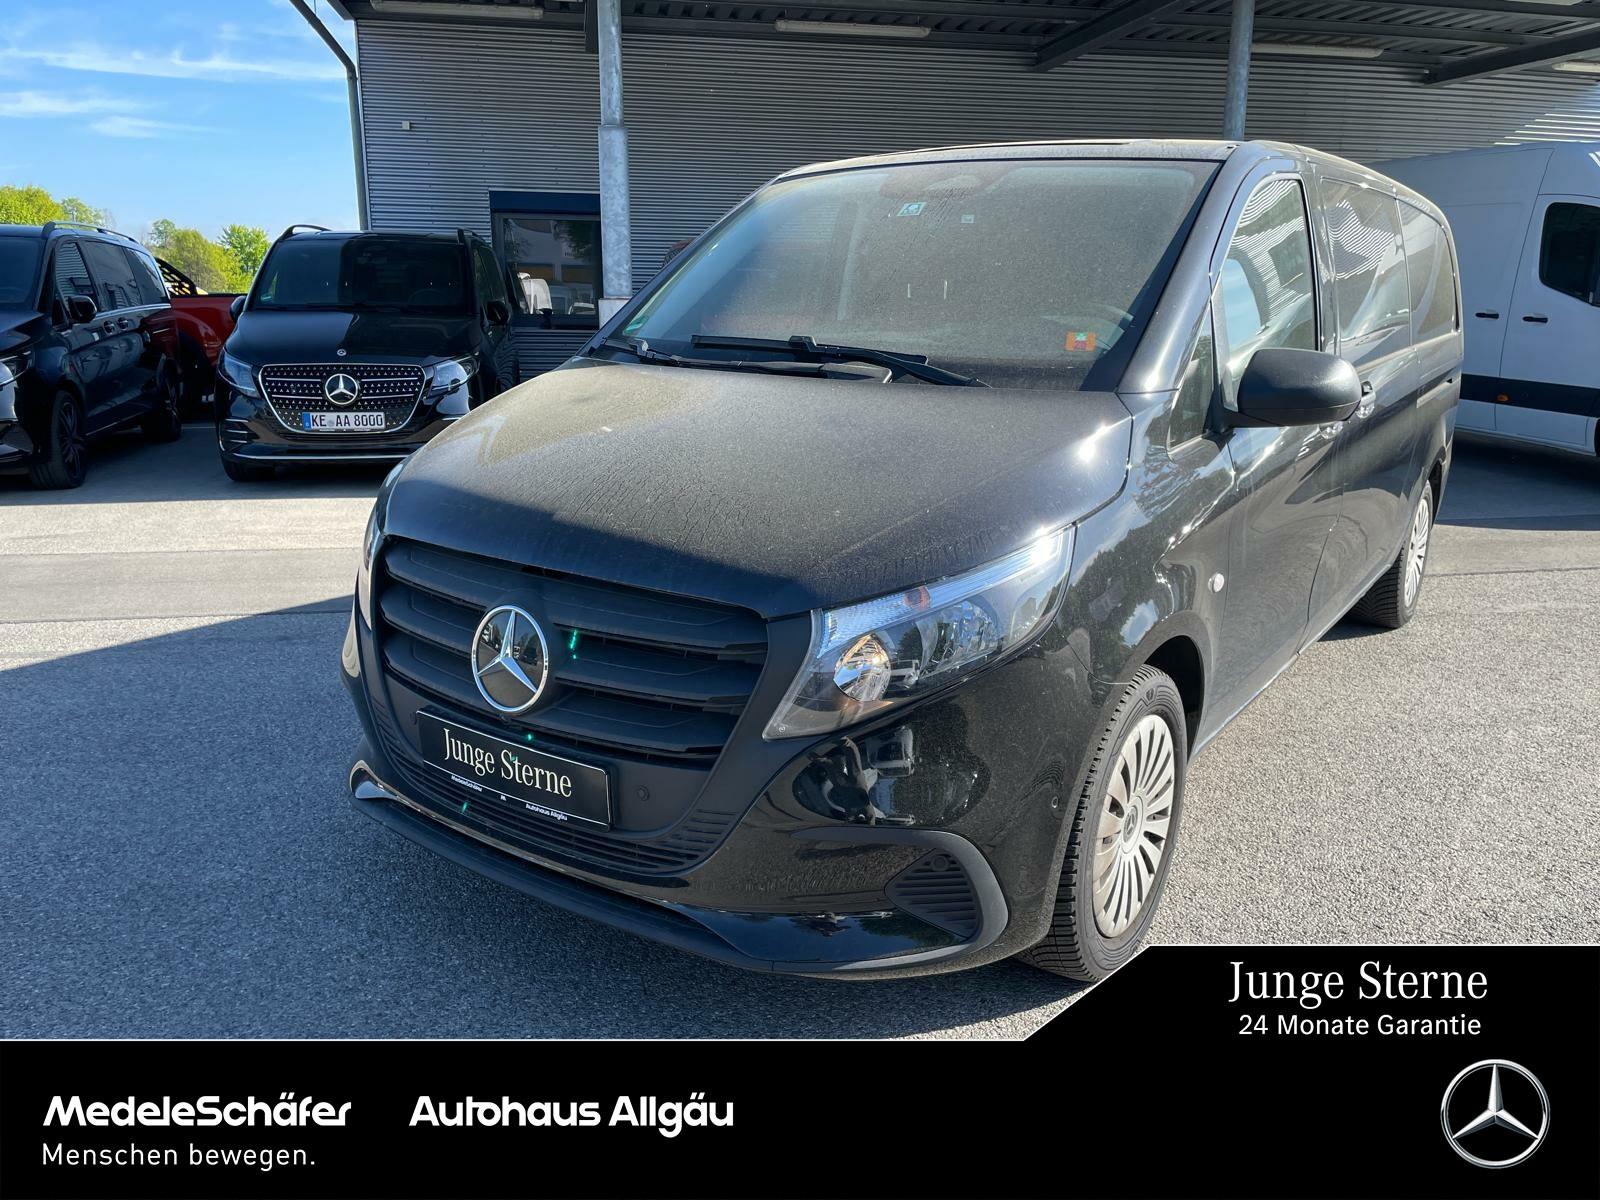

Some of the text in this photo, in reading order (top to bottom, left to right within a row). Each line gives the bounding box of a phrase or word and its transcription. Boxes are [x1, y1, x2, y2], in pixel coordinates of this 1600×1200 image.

[311, 414, 383, 427] KE AA 8000
[443, 727, 572, 798] Junge Sterne
